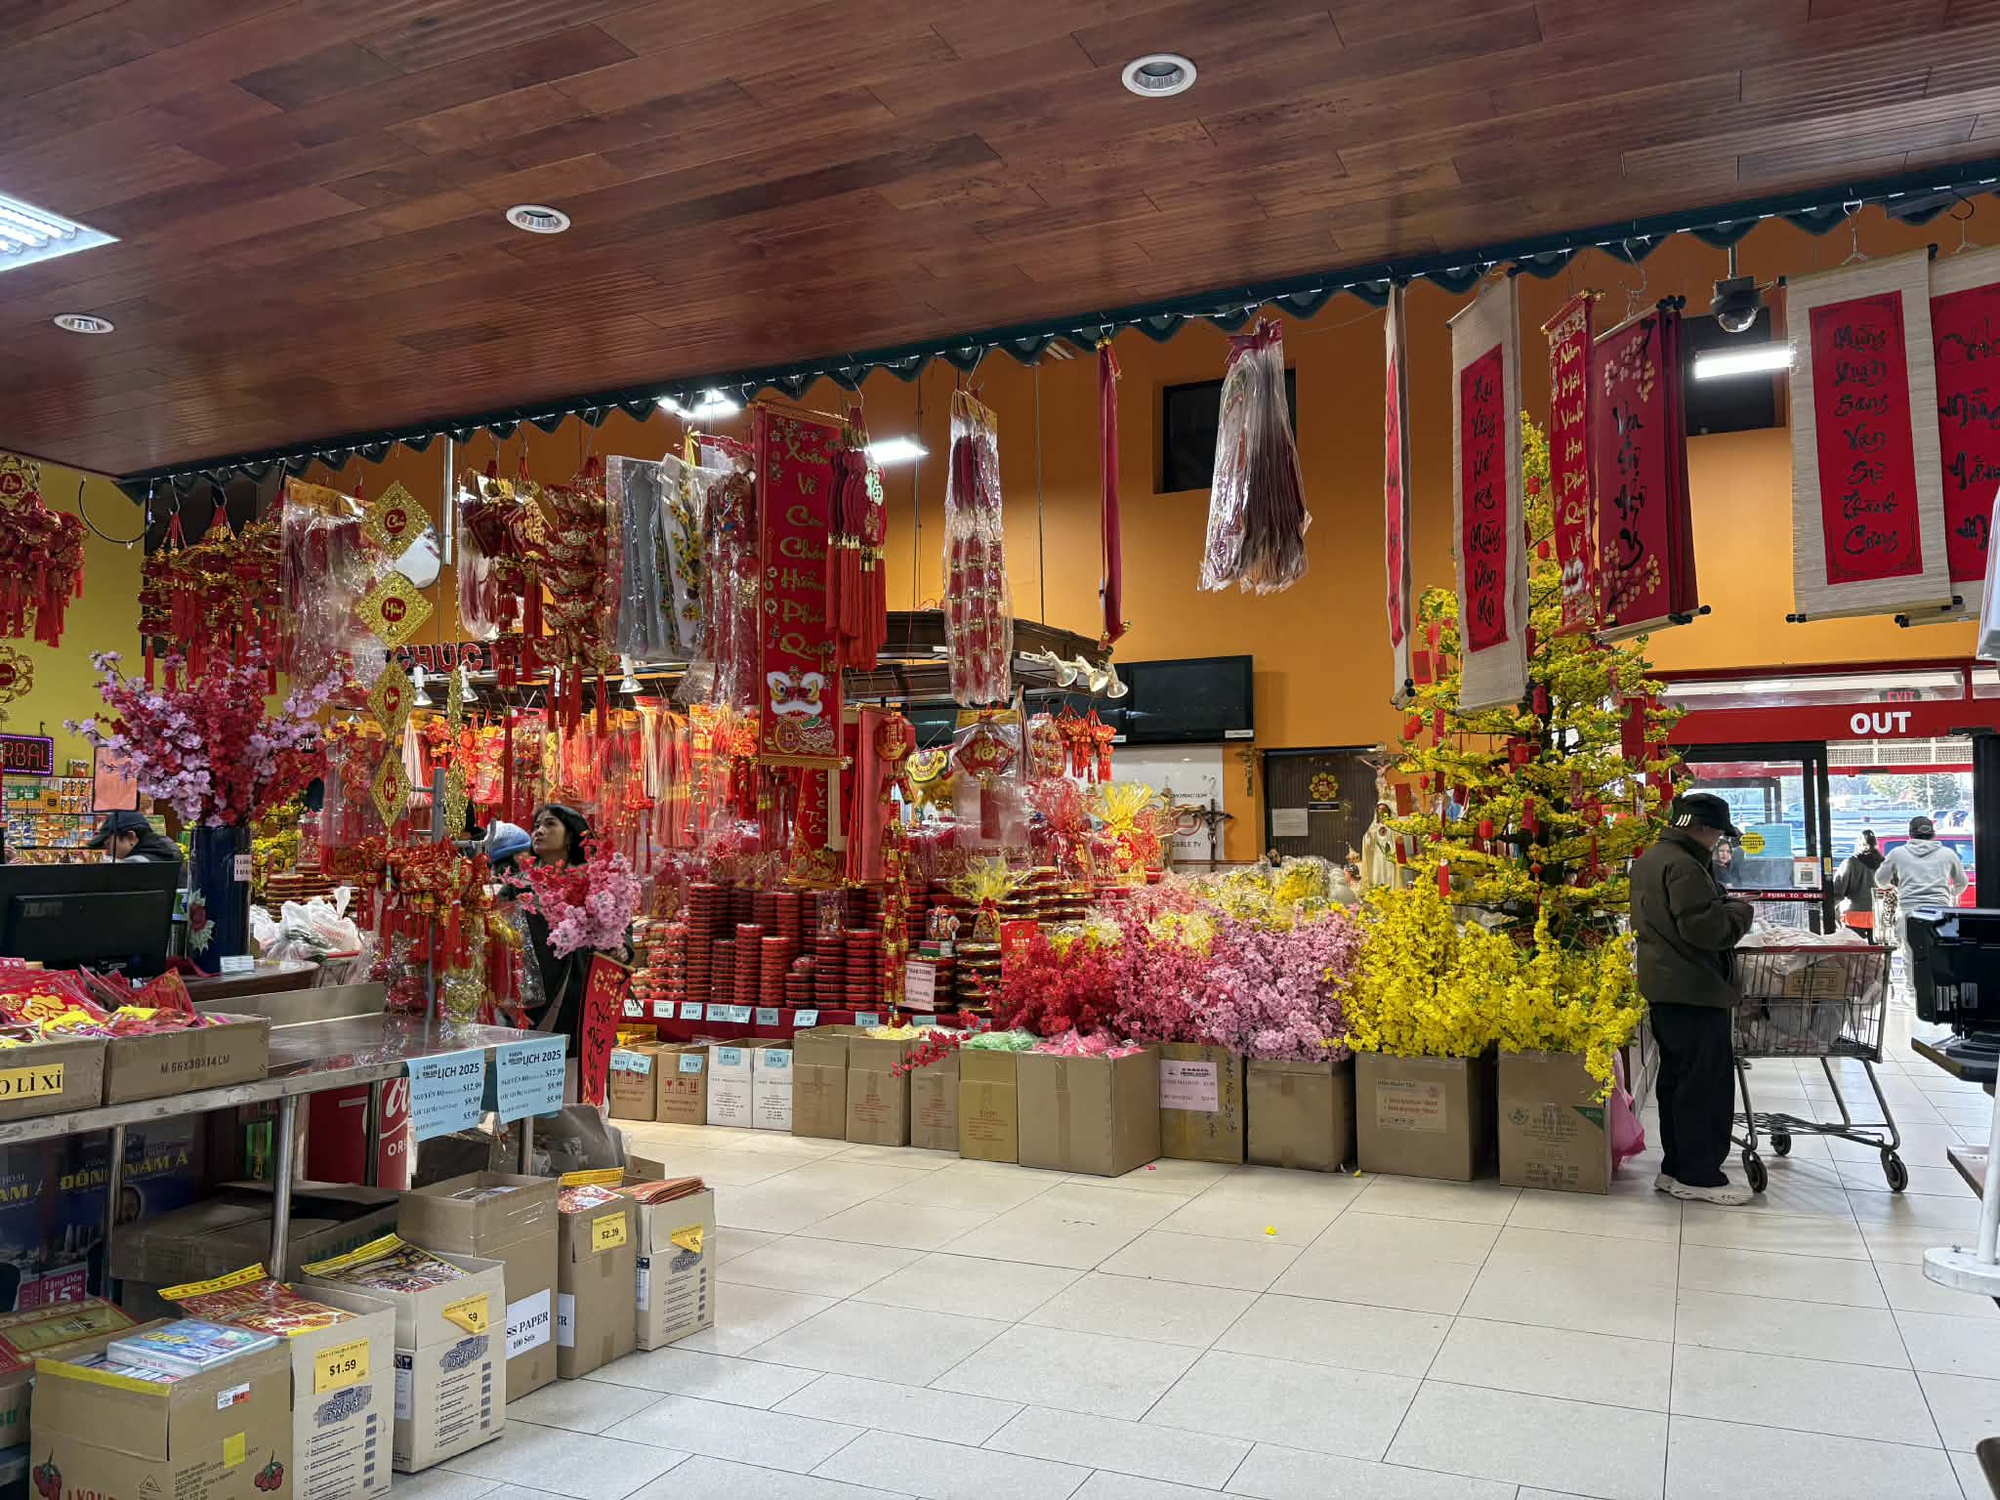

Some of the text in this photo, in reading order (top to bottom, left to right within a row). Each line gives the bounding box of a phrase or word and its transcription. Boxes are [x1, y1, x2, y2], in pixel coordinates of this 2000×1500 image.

[1850, 711, 1912, 735] OUT
[541, 1049, 562, 1062] 2025
[458, 1062, 480, 1075] 2025
[601, 1226, 619, 1240] $2.39
[519, 1311, 549, 1333] PAPER
[329, 1358, 357, 1377] $1.59
